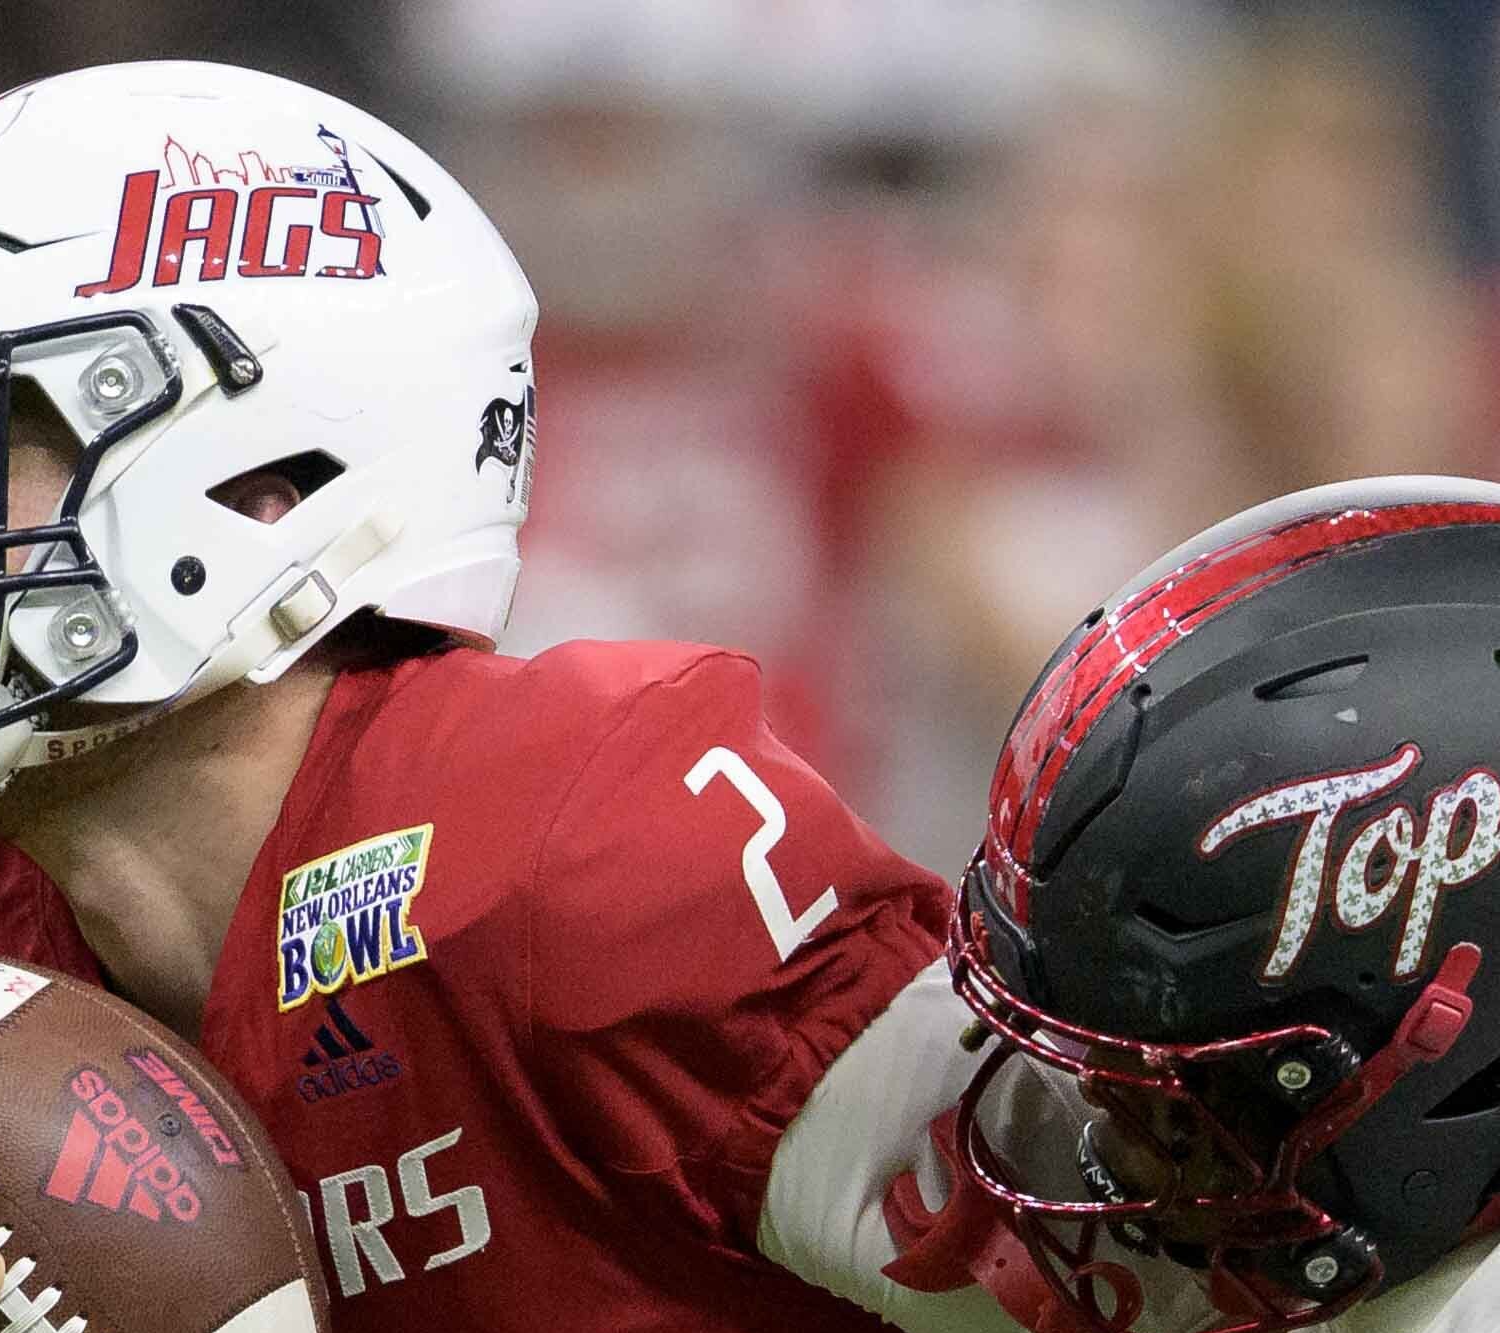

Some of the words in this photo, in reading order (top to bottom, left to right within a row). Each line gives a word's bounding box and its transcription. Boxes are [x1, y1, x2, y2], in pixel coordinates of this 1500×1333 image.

[74, 169, 382, 298] JAGS
[282, 899, 324, 938] NEW
[328, 865, 417, 920] ORLEANS
[684, 746, 839, 962] 2
[282, 898, 418, 1003] BOWL
[298, 1053, 402, 1104] adidas
[71, 1070, 200, 1222] adidas
[299, 1126, 491, 1298] RS
